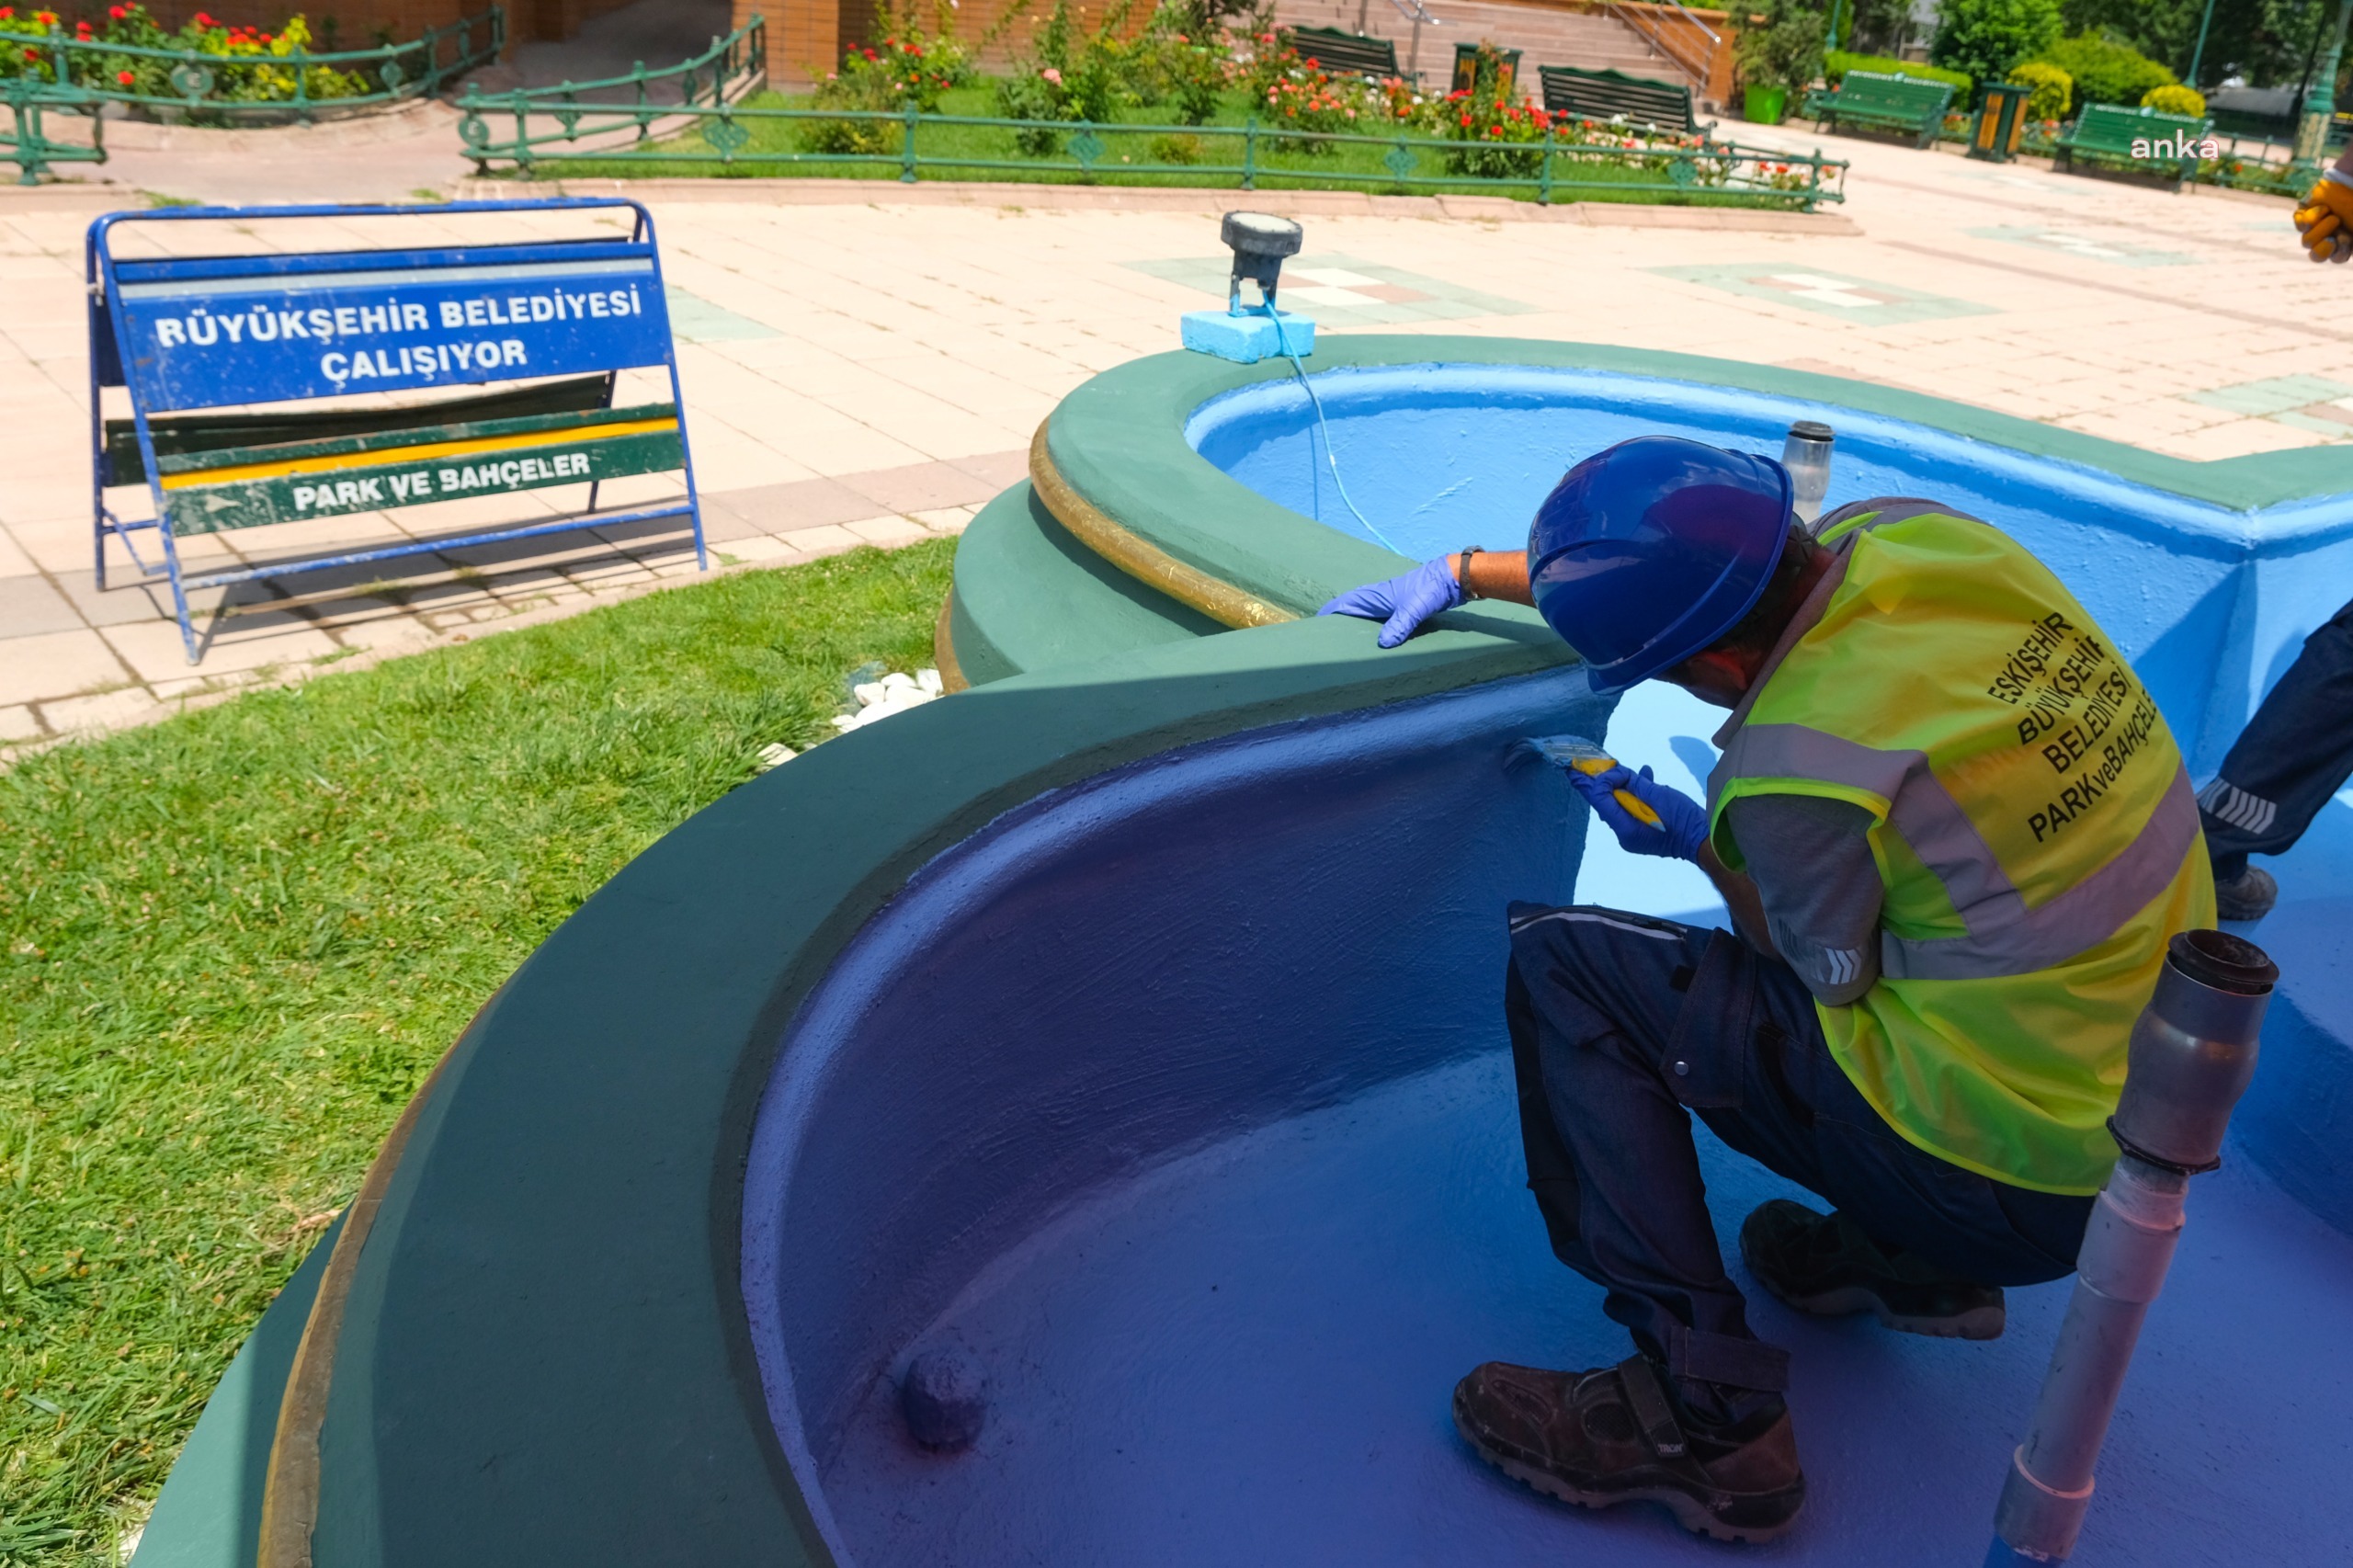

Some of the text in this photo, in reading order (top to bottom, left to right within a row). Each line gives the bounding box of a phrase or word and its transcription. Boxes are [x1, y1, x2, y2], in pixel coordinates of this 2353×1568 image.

[438, 283, 642, 328] BELEDİYESİ
[321, 339, 528, 388] ÇALIŞIYOR
[293, 452, 591, 511] PARK VE BAHÇELER
[1987, 611, 2075, 705] ESKİŞEHİR
